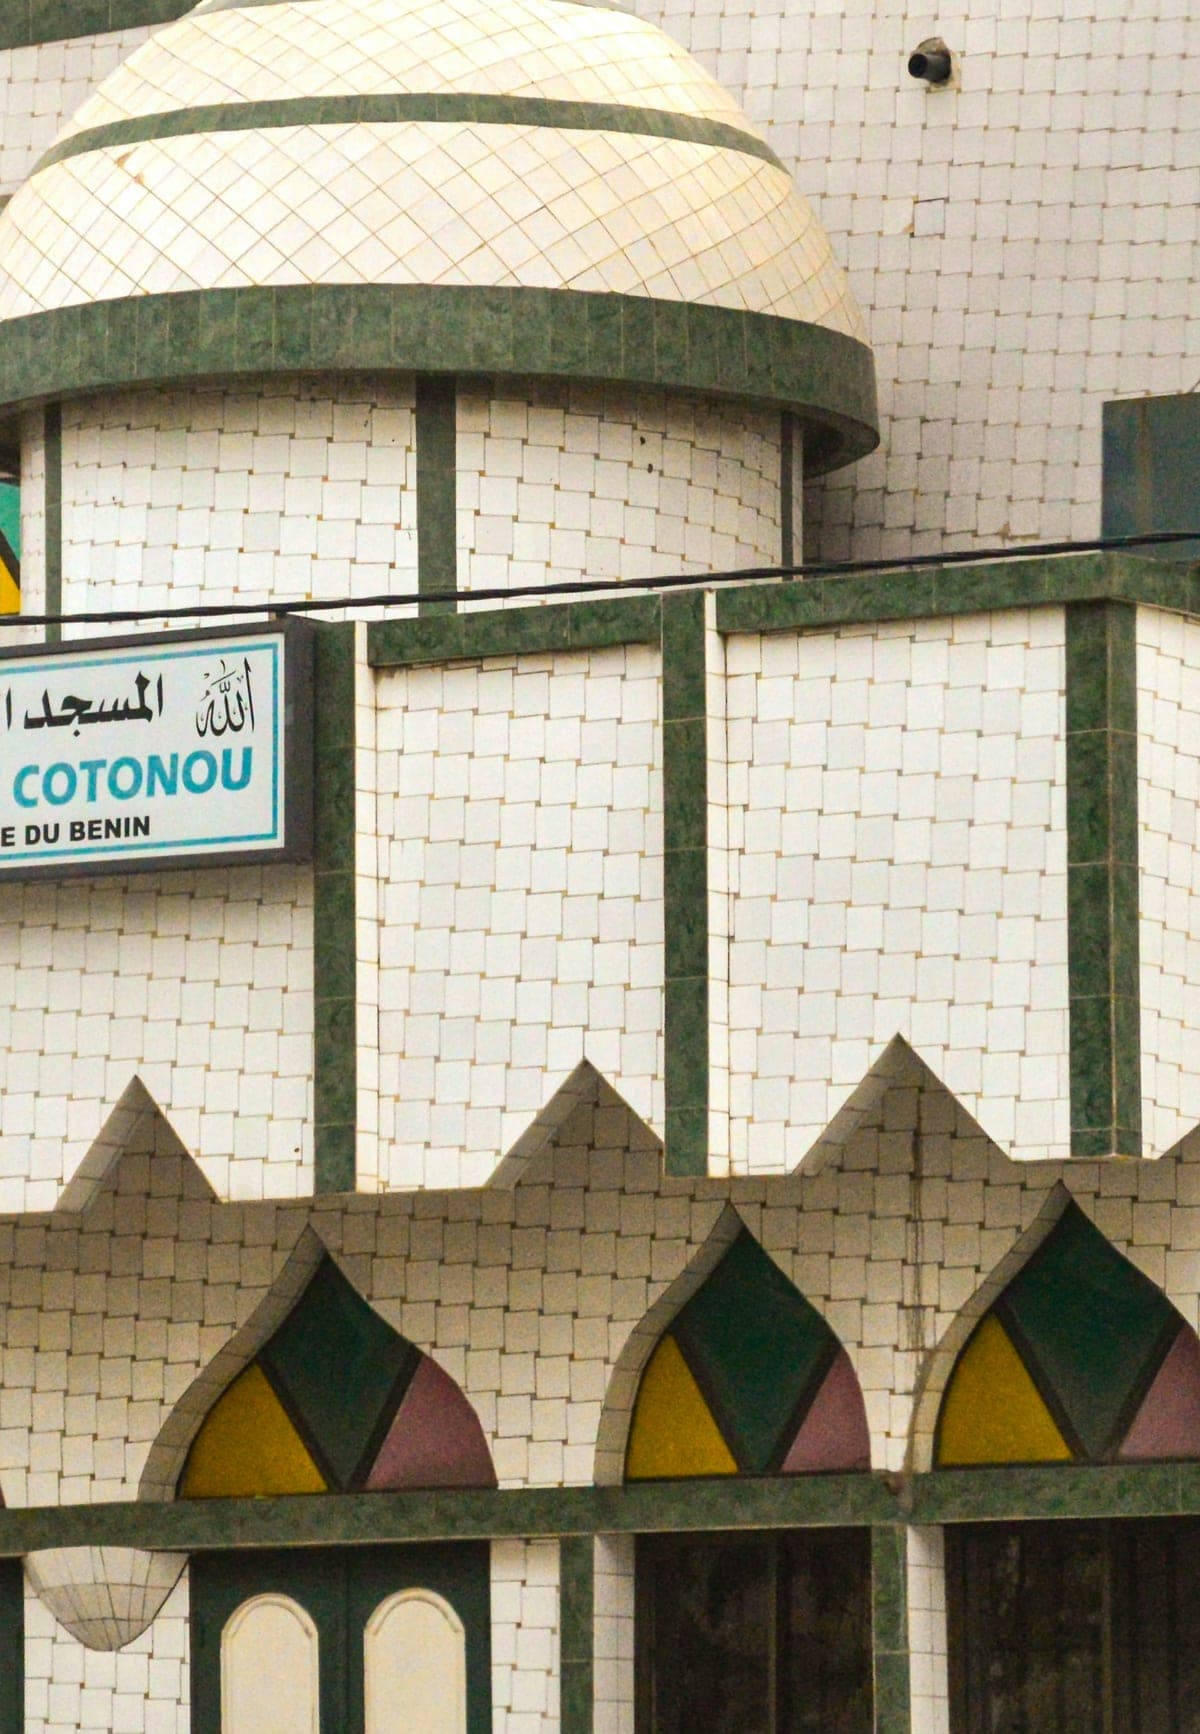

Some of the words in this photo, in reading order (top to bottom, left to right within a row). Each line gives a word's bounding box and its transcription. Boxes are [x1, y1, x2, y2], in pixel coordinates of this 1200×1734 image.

[23, 671, 164, 738] المسجد
[12, 746, 253, 809] COTONOU
[25, 822, 60, 846] DU
[69, 815, 150, 842] BENIN
